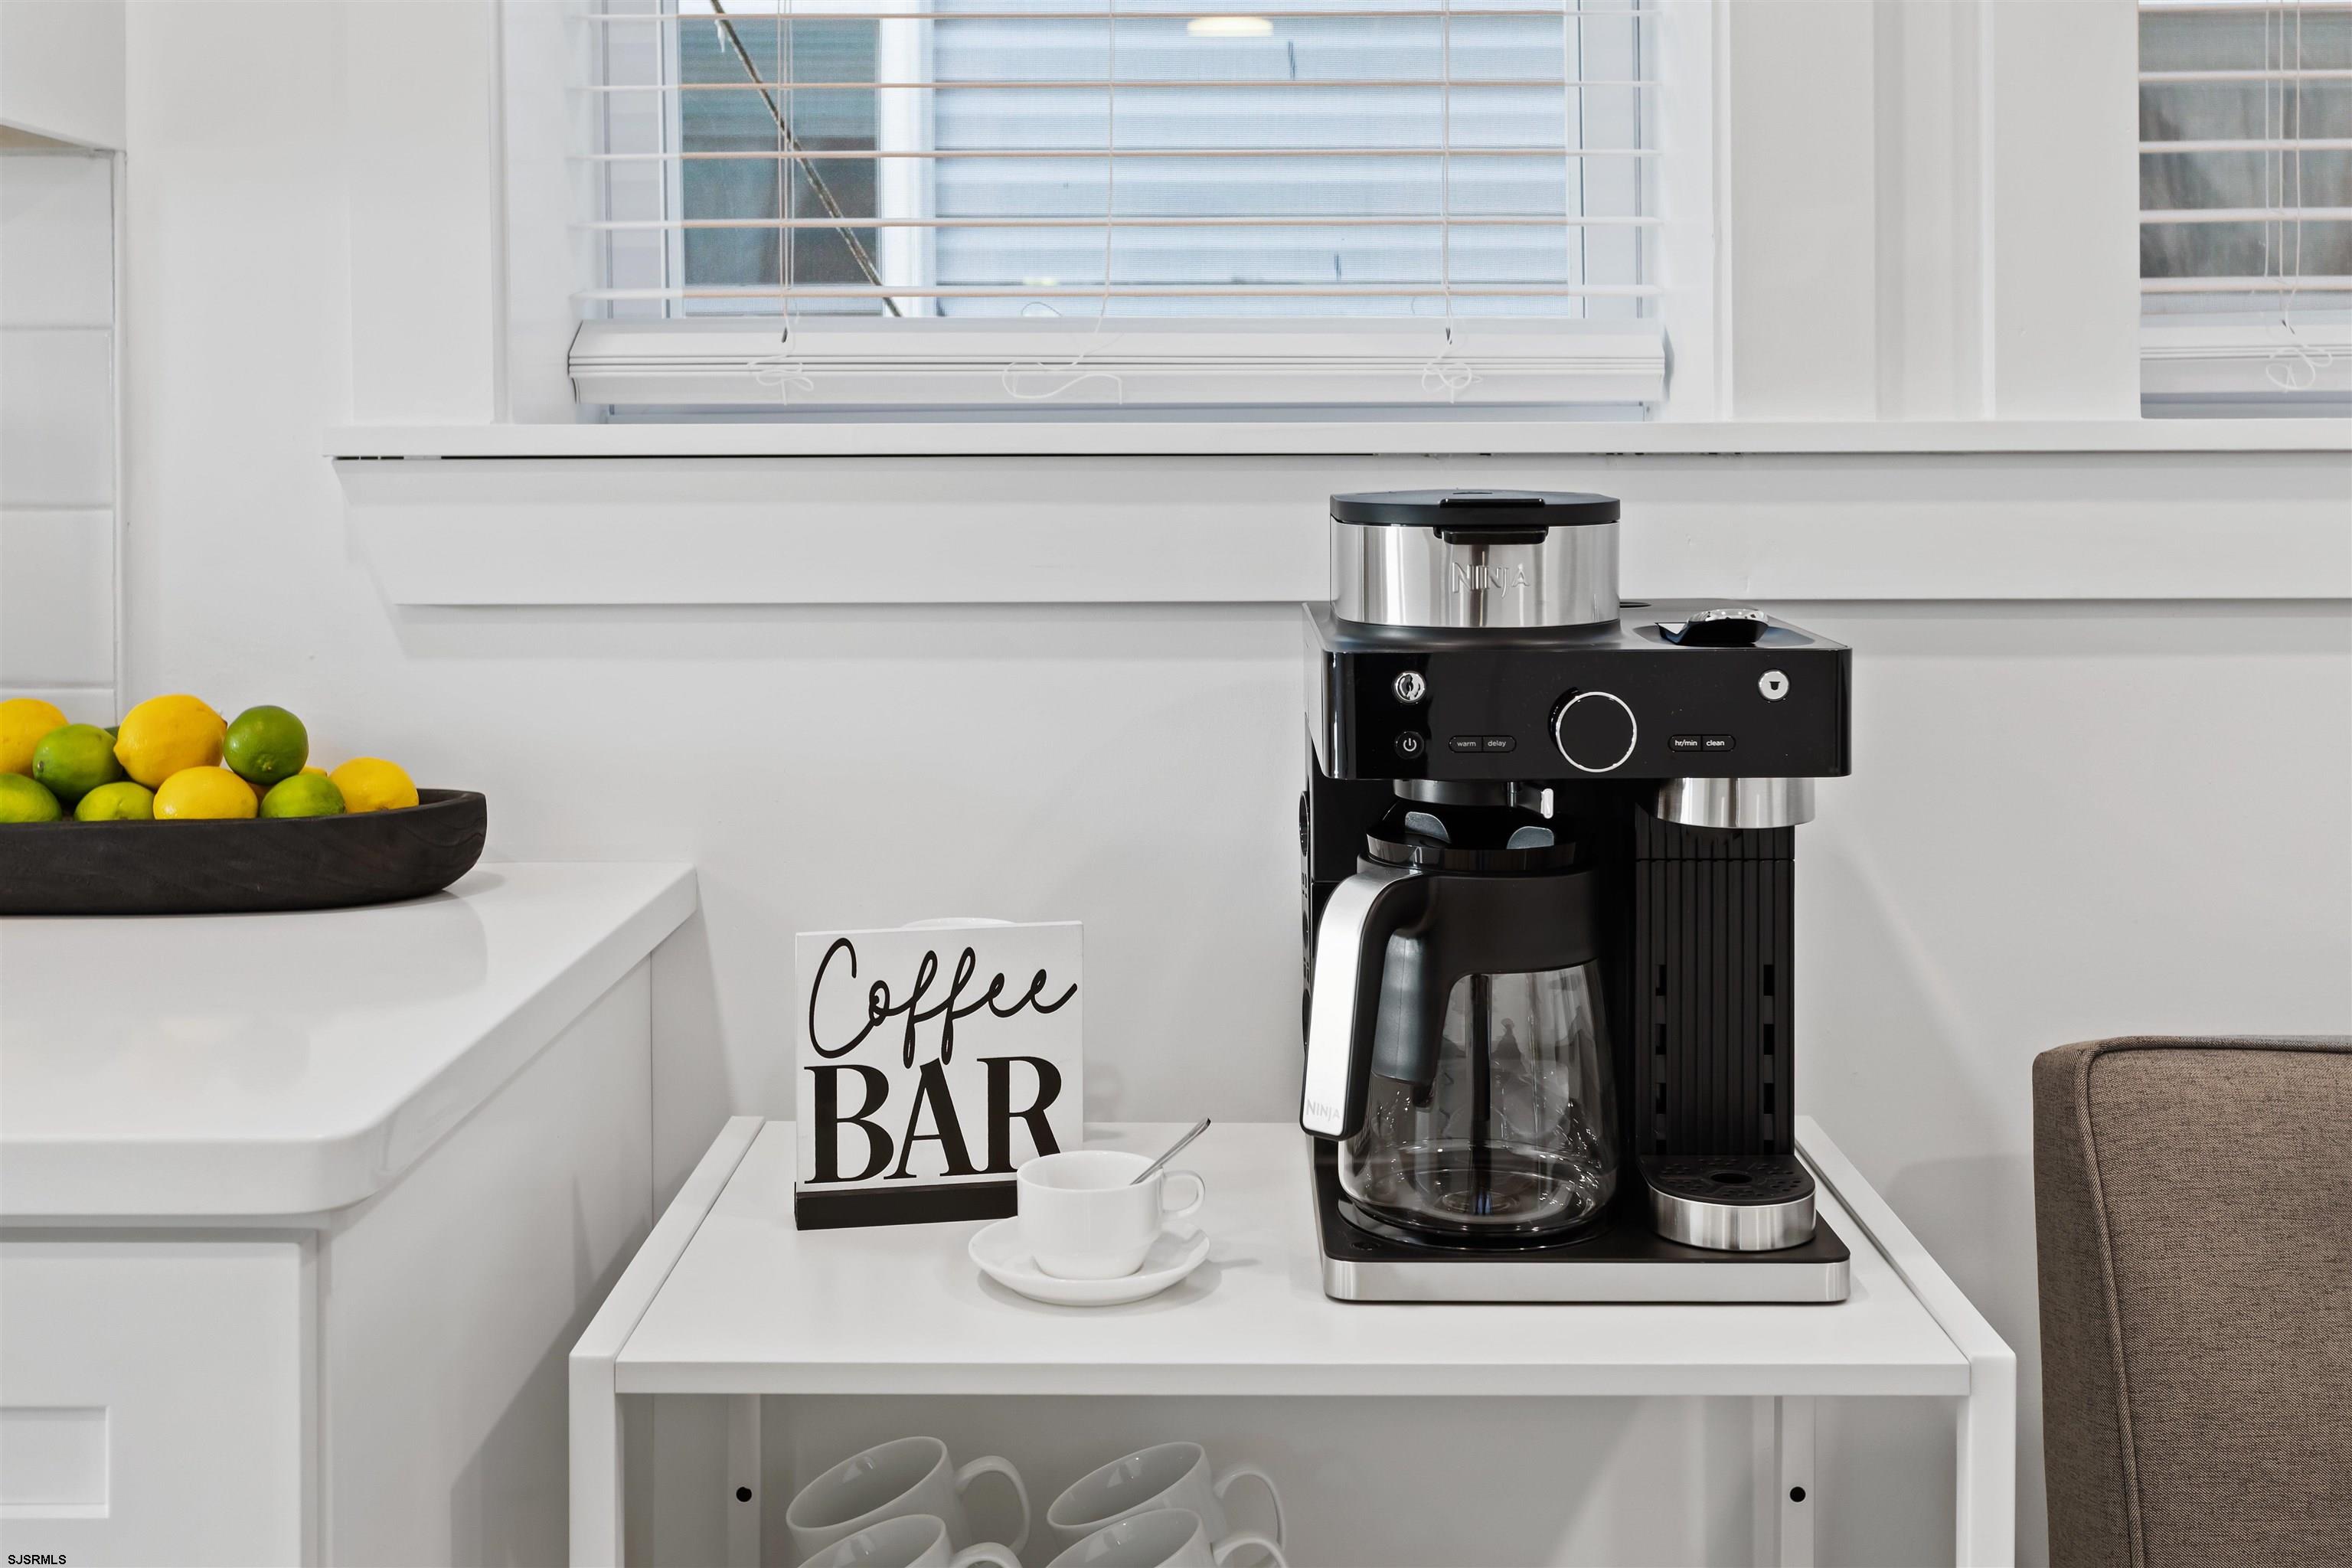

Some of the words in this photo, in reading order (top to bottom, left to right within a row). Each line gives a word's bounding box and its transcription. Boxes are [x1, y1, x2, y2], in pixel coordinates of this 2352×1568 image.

[1452, 562, 1531, 599] NINJA
[1674, 739, 1698, 747] hr/min
[809, 937, 1078, 1070] Coffee
[804, 1056, 1063, 1184] BAR
[1305, 1098, 1341, 1122] NINJA
